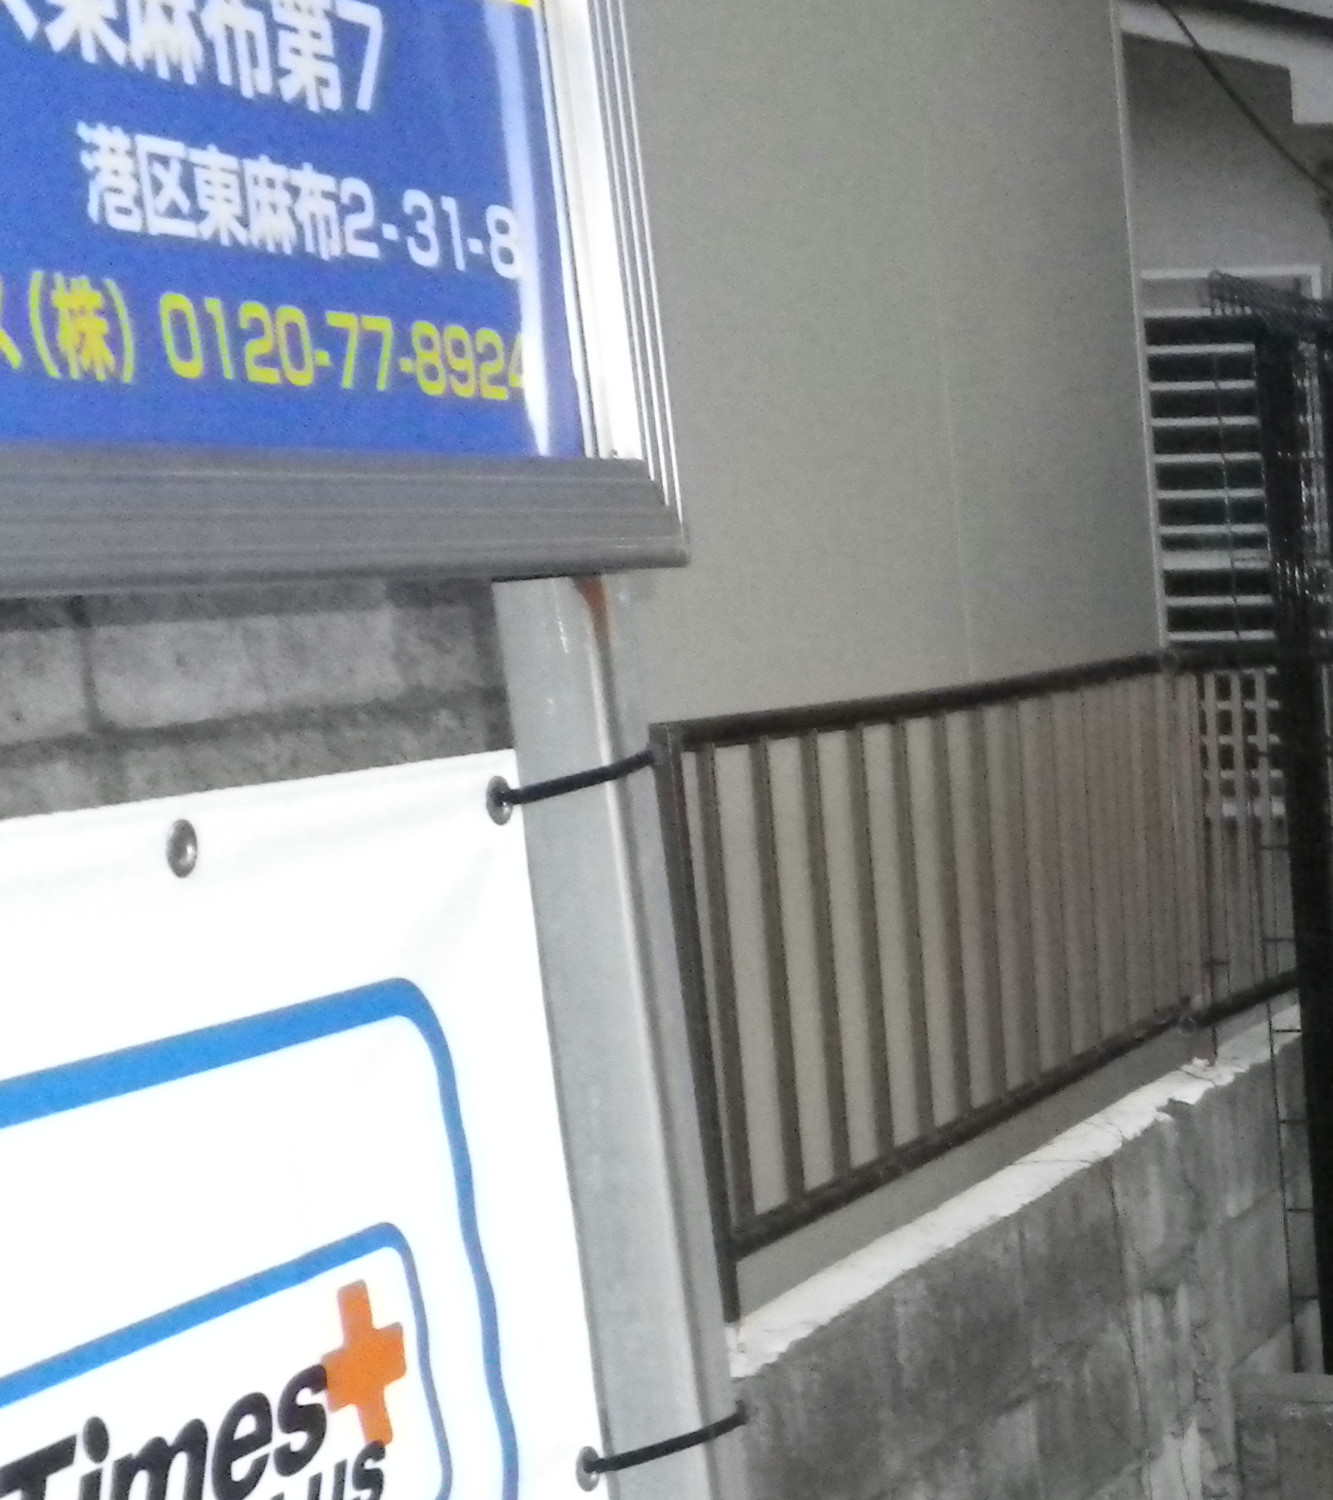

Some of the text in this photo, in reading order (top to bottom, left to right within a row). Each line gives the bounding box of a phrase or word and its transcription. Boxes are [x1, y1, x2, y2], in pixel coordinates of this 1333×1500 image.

[0, 0, 384, 112] 麻布第7
[77, 119, 524, 281] 港区東麻布2-31-8
